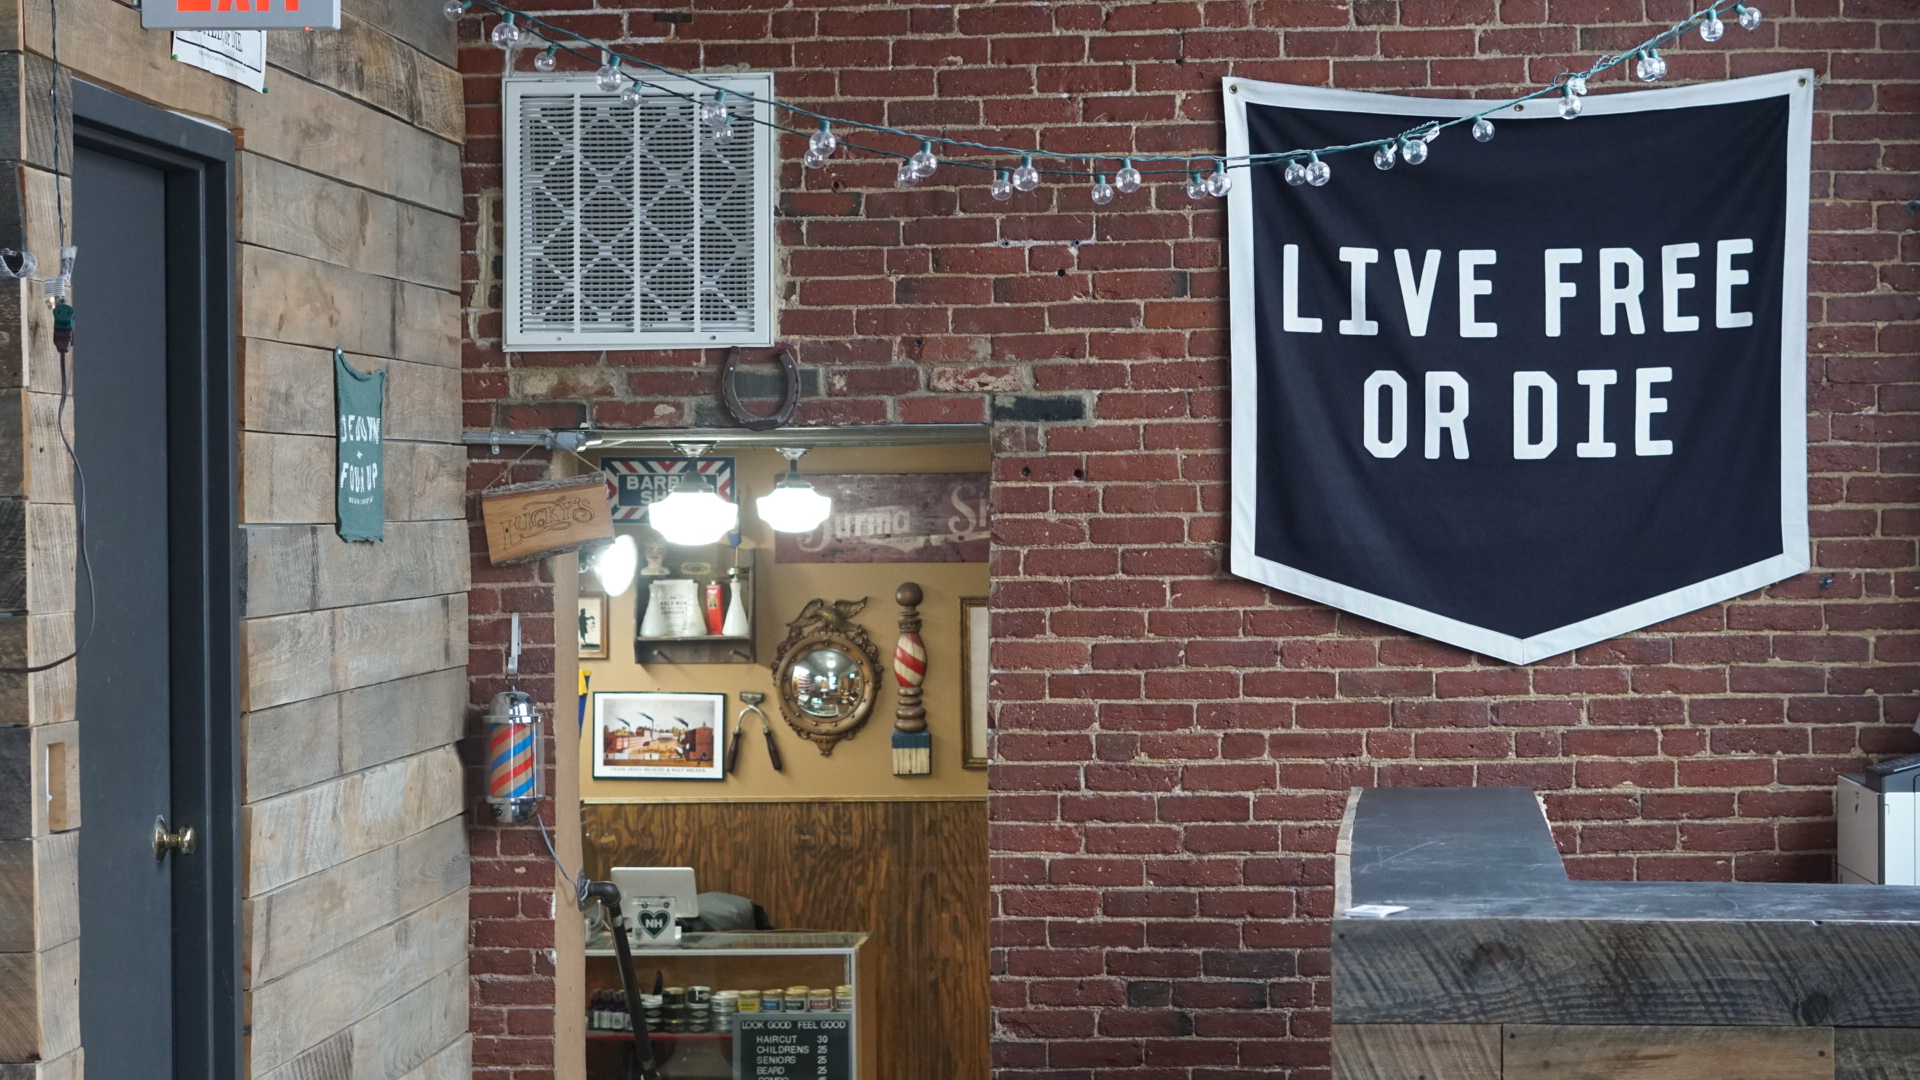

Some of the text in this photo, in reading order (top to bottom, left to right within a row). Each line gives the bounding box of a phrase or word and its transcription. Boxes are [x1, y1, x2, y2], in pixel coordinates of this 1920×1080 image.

[1283, 238, 1754, 338] LIVE FREE
[1363, 366, 1673, 460] OR DIE
[626, 475, 707, 492] BARB
[645, 919, 663, 928] NH
[741, 1021, 846, 1029] LOOK GOOD FEEL GOOD
[756, 1035, 828, 1043] HAIRCUT 30
[756, 1045, 828, 1054] CHILDRENS 25
[756, 1056, 828, 1064] SENIORS 25
[756, 1066, 828, 1075] BEARD 25
